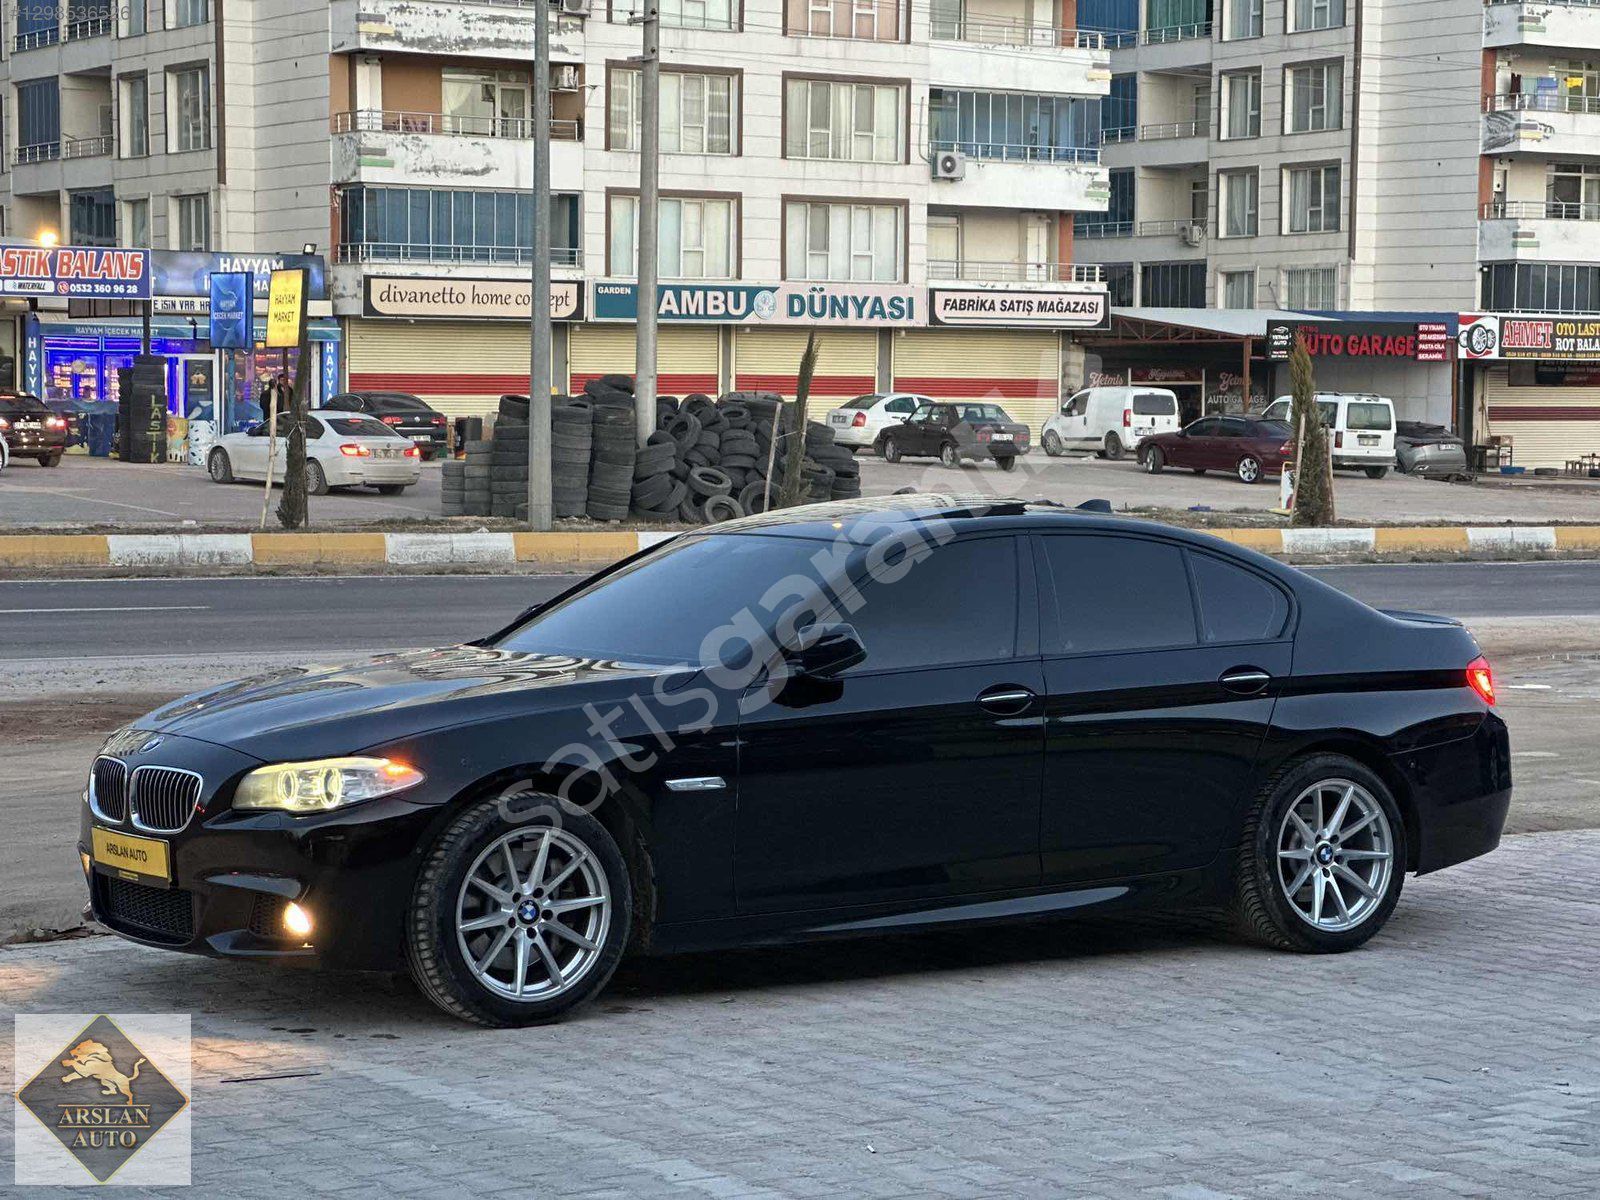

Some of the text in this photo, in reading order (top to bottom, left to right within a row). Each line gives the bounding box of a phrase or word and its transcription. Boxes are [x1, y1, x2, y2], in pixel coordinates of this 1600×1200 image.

[55, 250, 144, 280] BALANS
[219, 257, 284, 274] HAYYAM
[70, 284, 138, 294] 0532 360 96 28
[597, 286, 631, 296] GARDEN
[179, 299, 195, 309] VAR
[379, 284, 571, 312] divanetto home coept
[657, 287, 915, 320] AMBU DÜNYASI
[943, 296, 1100, 316] FABRİKA SATIŞ MAĞAZASI
[273, 311, 295, 323] MARKET
[75, 327, 103, 335] HAYYAM
[1501, 320, 1553, 348] AHMET
[1556, 322, 1575, 336] OTO
[1347, 334, 1416, 357] GARAGE
[1555, 338, 1575, 351] ROT
[1207, 394, 1265, 404] AUTO GAAGE
[106, 842, 148, 862] ARSLAN AUTO
